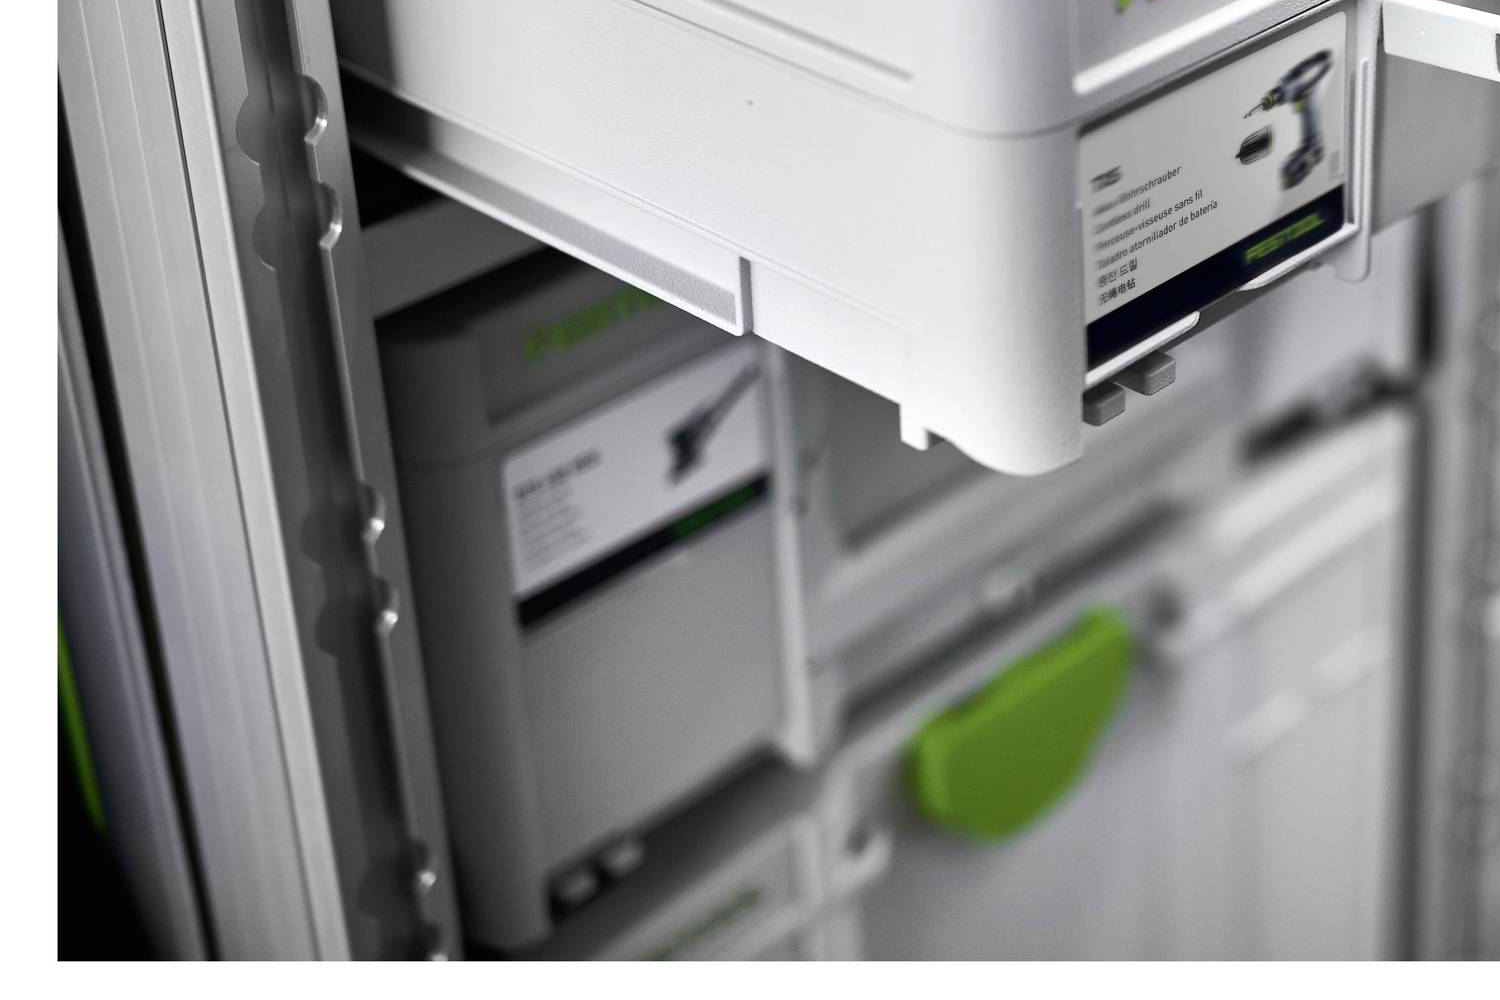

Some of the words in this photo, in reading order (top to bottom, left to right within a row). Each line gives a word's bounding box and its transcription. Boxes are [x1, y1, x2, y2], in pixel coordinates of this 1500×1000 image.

[1133, 198, 1151, 215] drill
[1174, 196, 1194, 212] sans
[1194, 188, 1204, 201] fil
[1129, 223, 1177, 252] atornillador
[1178, 215, 1189, 227] de
[1190, 200, 1218, 220] batería
